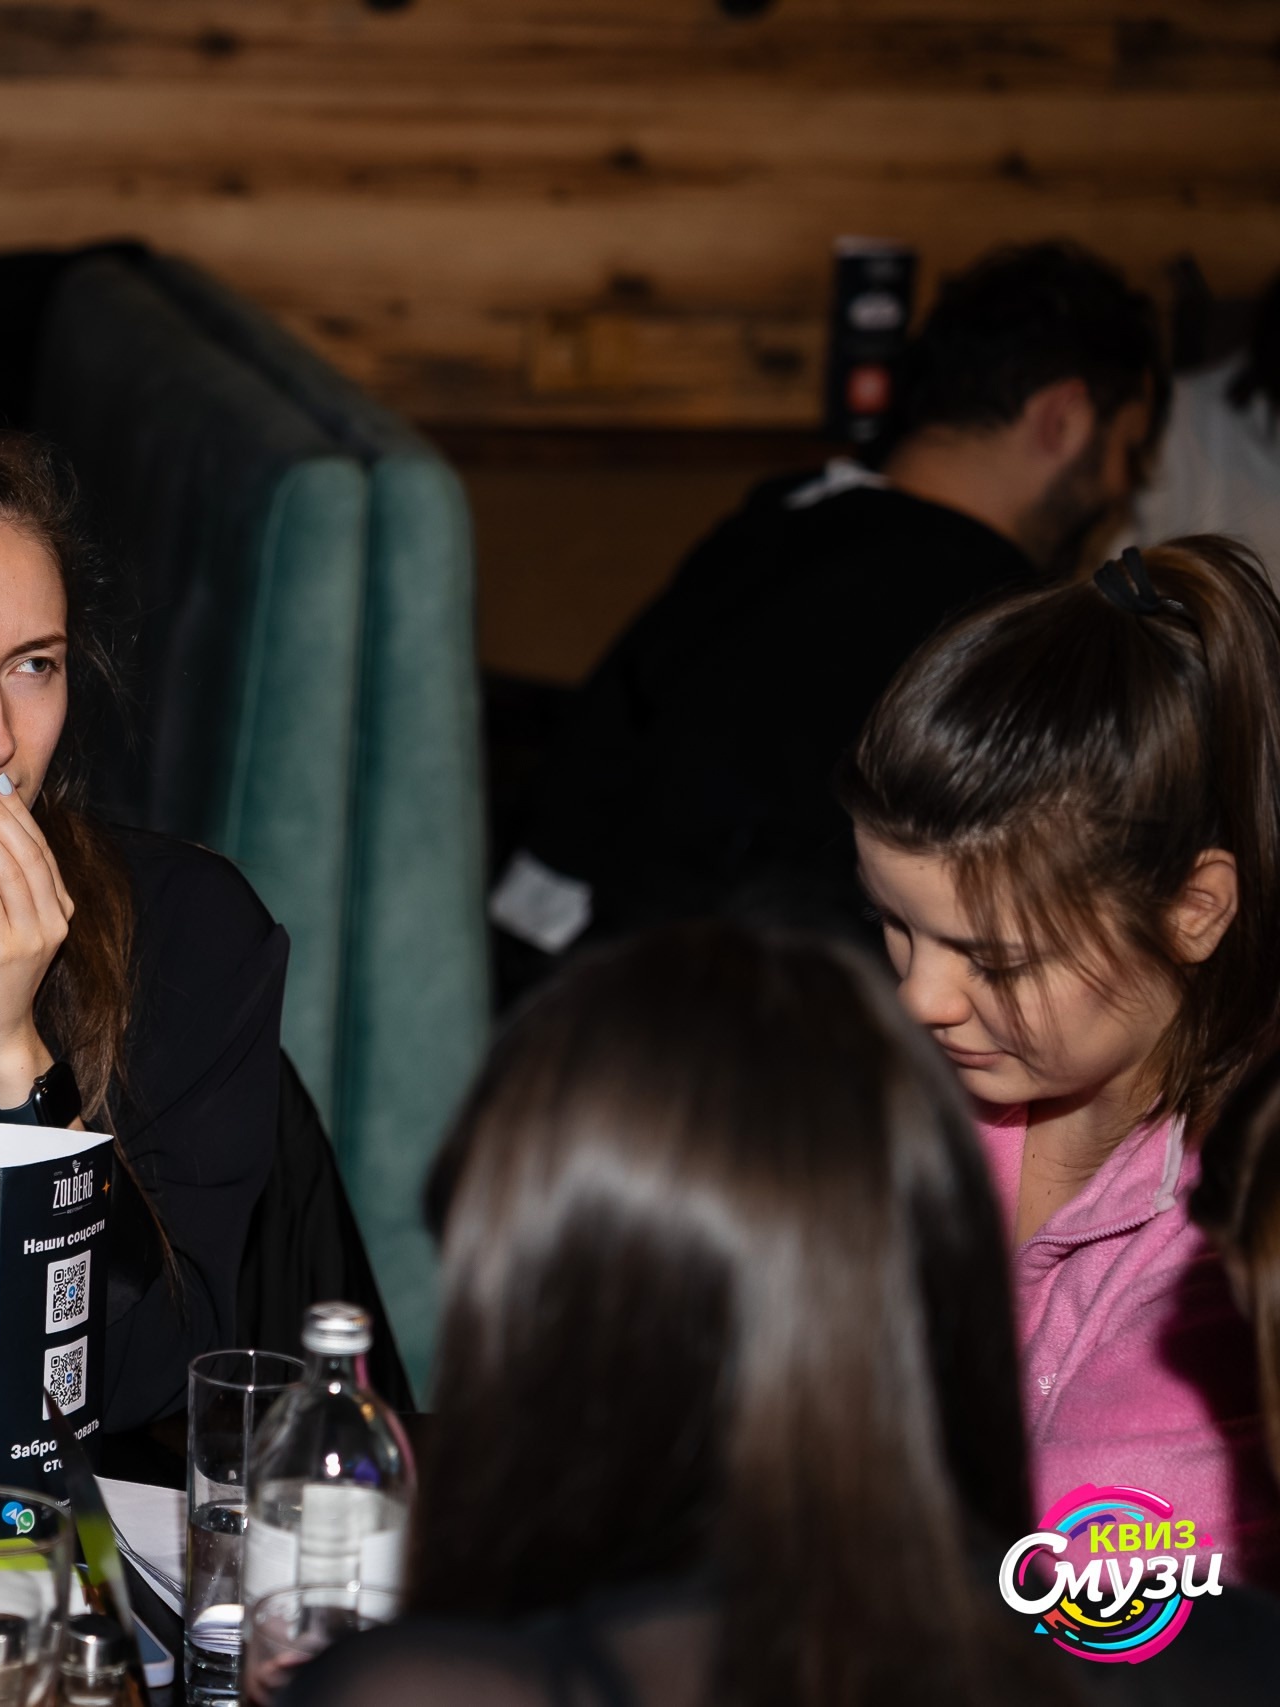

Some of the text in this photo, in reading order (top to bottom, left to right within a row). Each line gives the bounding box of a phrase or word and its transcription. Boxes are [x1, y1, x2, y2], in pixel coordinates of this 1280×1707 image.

[52, 1169, 93, 1209] ZOLBERG
[23, 1219, 105, 1255] Наши соцсети
[10, 1418, 100, 1460] Заброовать
